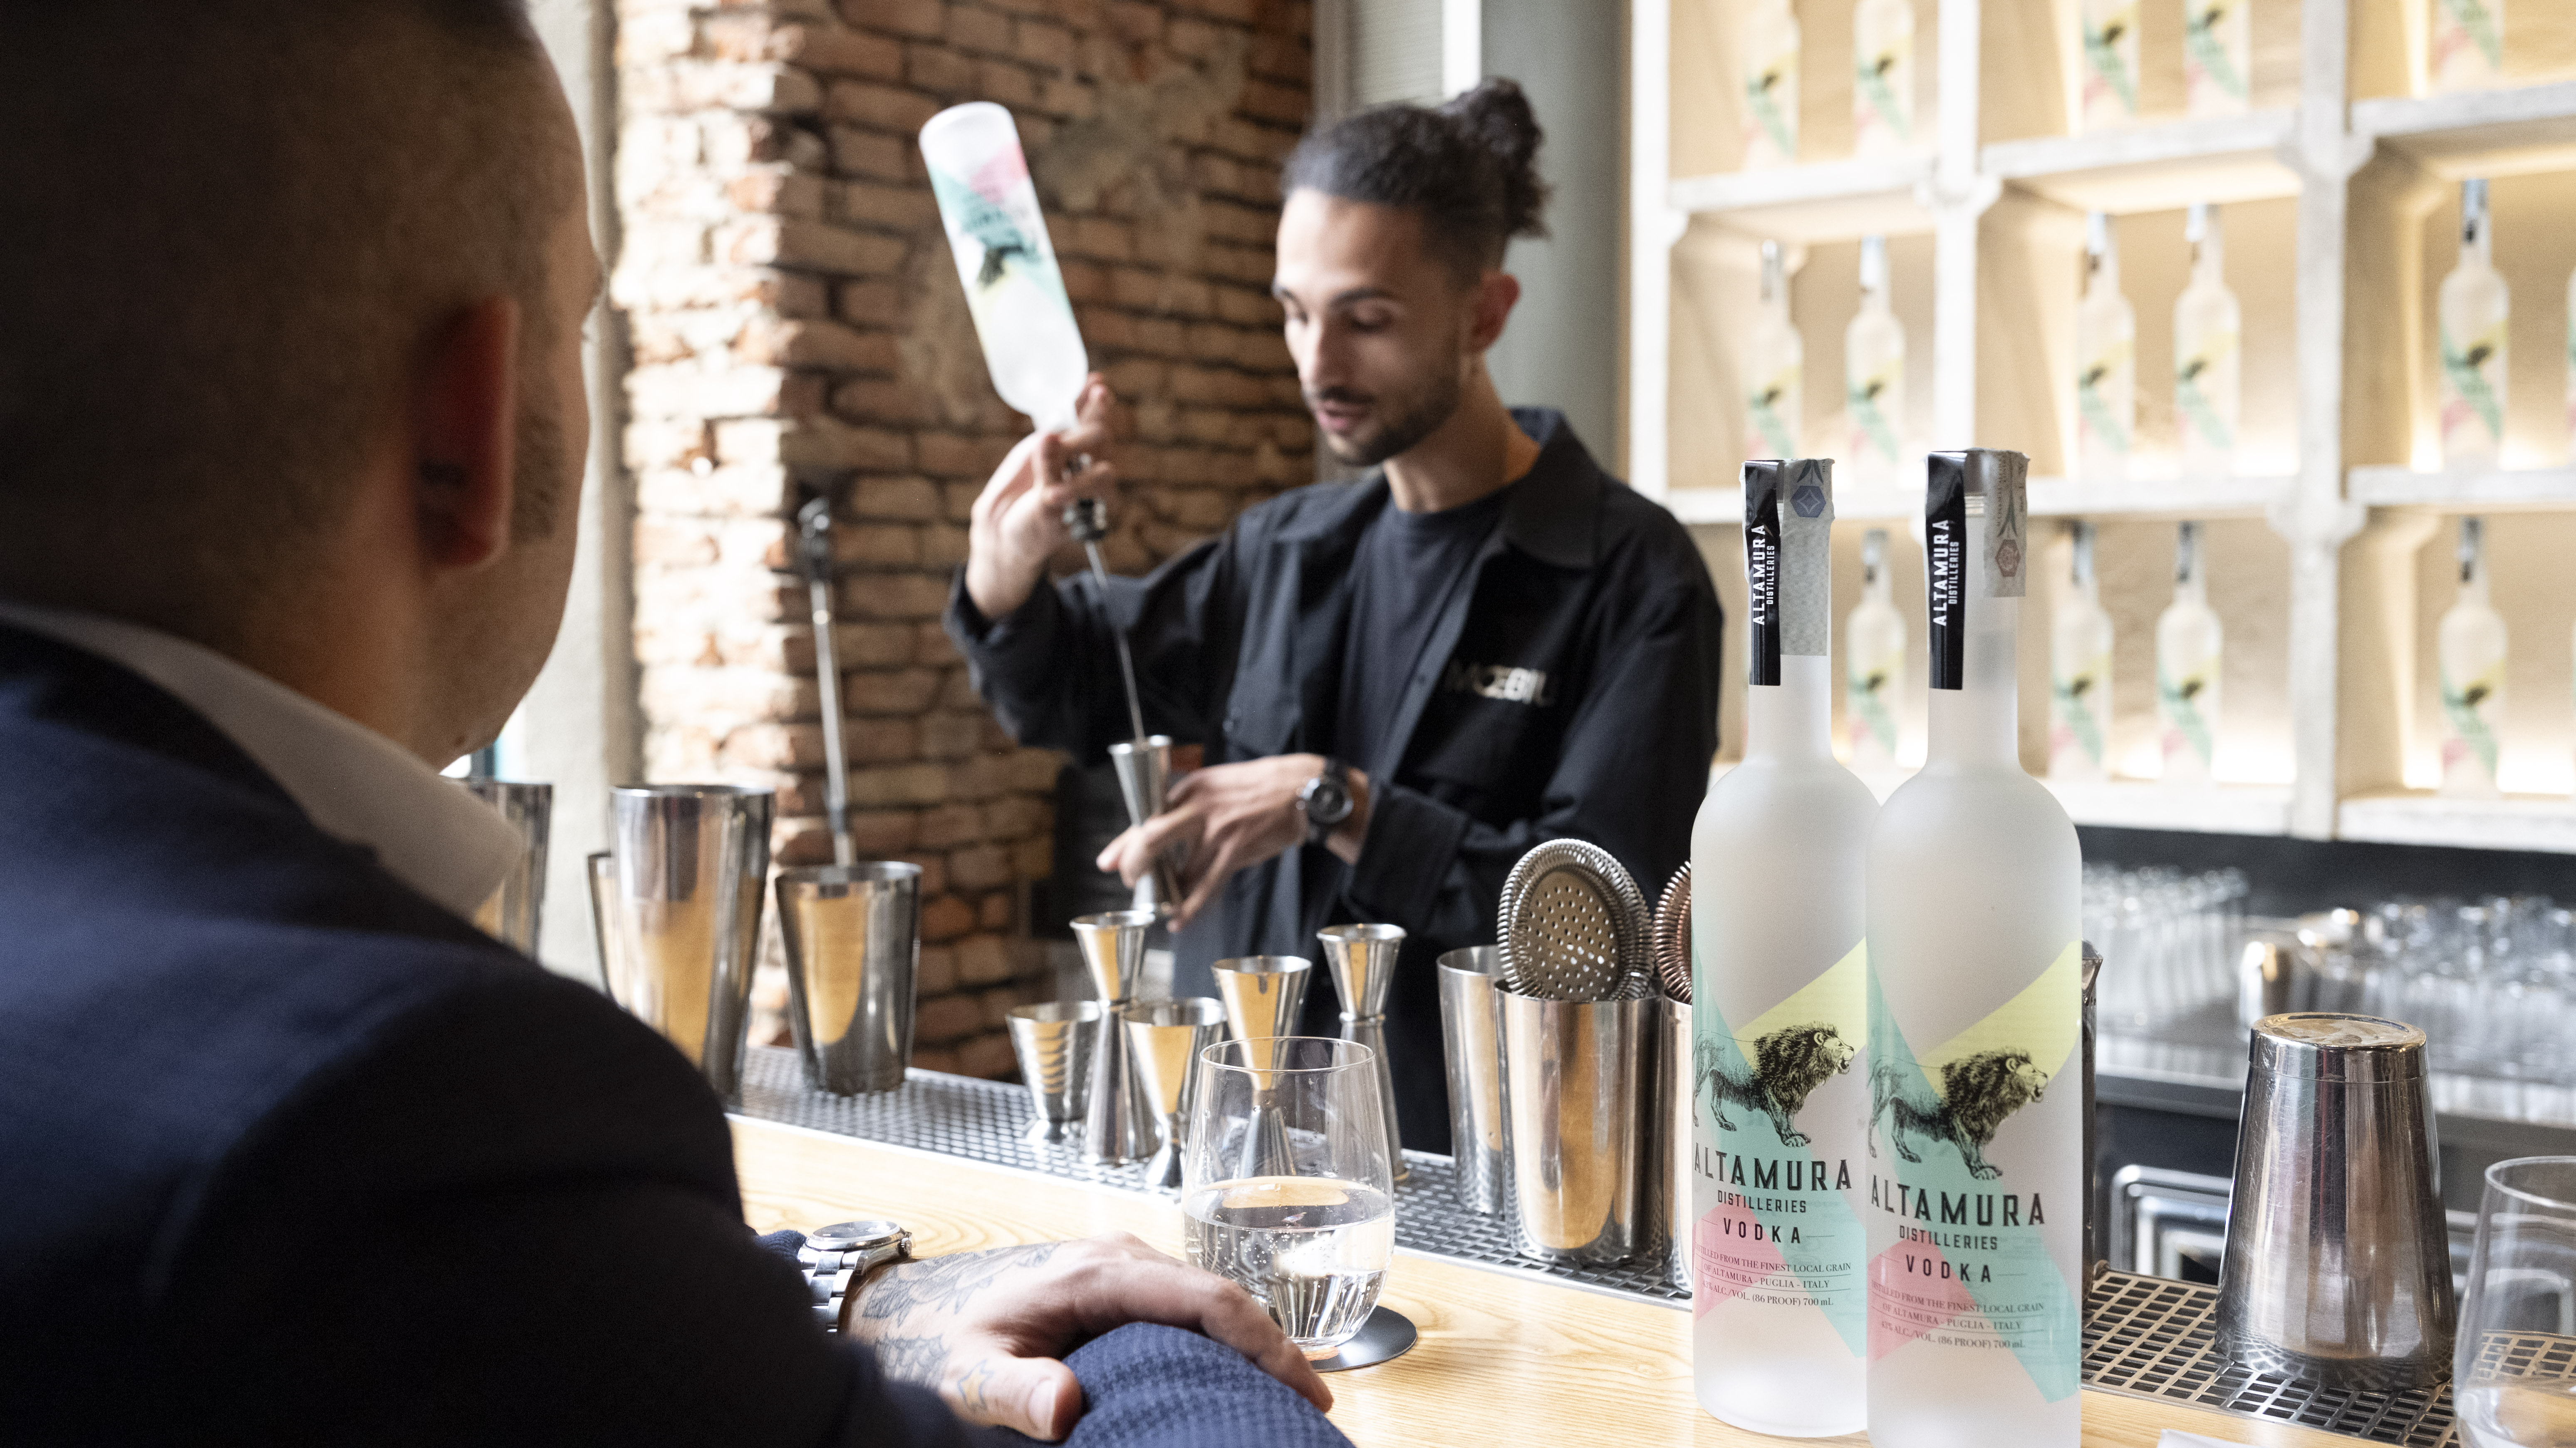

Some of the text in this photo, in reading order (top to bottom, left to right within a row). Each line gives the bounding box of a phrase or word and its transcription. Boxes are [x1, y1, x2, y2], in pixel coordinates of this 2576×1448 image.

[1751, 525, 1766, 625] ALTAMURA
[1766, 545, 1775, 605] DISTILLERIES
[1932, 520, 1949, 626] ALTAMURA
[1948, 542, 1959, 604] DISTILLERIES
[1694, 1142, 1852, 1191] ALTAMURA
[1718, 1190, 1806, 1213] DISTILLERIES
[1871, 1174, 2045, 1227] ALTAMURA
[1724, 1217, 1801, 1244] VODKA
[1900, 1225, 1997, 1250] DISTILLERIES
[1704, 1263, 1712, 1272] OF
[1712, 1268, 1753, 1283] ALTAMURA
[1760, 1277, 1795, 1288] PUGLIA
[1803, 1280, 1830, 1288] ITALY
[1720, 1254, 1740, 1265] FROM
[1741, 1258, 1759, 1269] THE
[1761, 1262, 1792, 1272] FINEST
[1826, 1262, 1851, 1272] GRAIN
[1906, 1254, 1991, 1283] VODKA
[1702, 1279, 1713, 1291] 43%
[1713, 1285, 1750, 1300] ALC./VOL.
[1752, 1294, 1765, 1302] (86
[1768, 1296, 1801, 1306] PROOF)
[1902, 1292, 1924, 1305] FROM
[1927, 1298, 1945, 1309] THE
[1947, 1302, 1980, 1312] FINEST
[1983, 1304, 2015, 1313] LOCAL
[2017, 1303, 2044, 1312] GRAIN
[1883, 1303, 1891, 1312] OF
[1894, 1307, 1939, 1325] ALTAMURA
[1947, 1318, 1984, 1329] PUGLIA
[1994, 1321, 2021, 1329] ITALY
[1938, 1336, 1952, 1345] (86
[1954, 1337, 1991, 1349] PROOF)
[1994, 1340, 2010, 1348] 700
